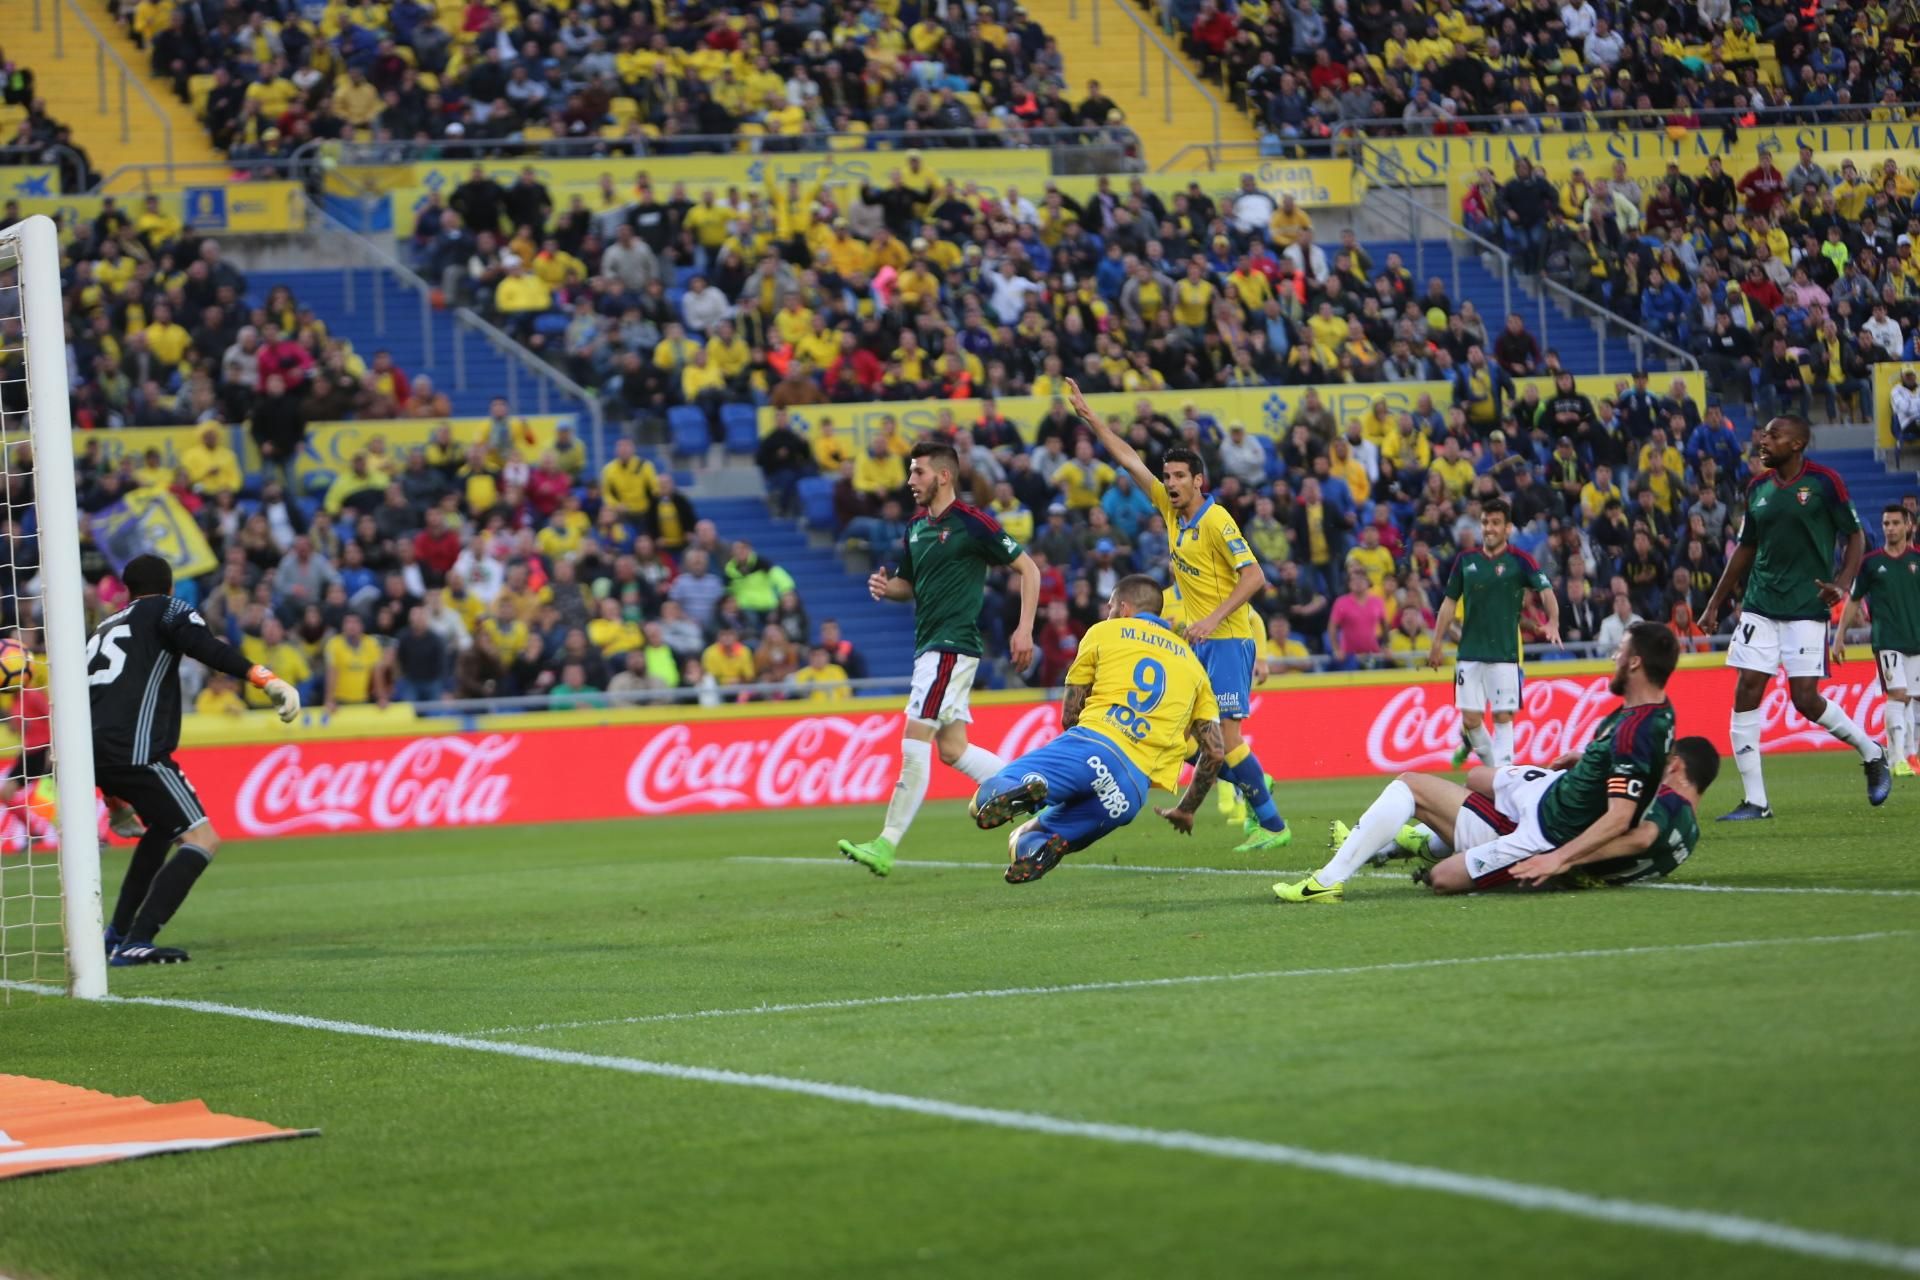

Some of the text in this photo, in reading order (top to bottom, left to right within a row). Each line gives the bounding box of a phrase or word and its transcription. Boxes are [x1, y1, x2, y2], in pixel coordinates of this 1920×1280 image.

[1127, 657, 1165, 714] 9
[235, 734, 522, 836] Coca-Cola
[626, 714, 900, 814] Coca-Cola
[1627, 779, 1643, 797] C
